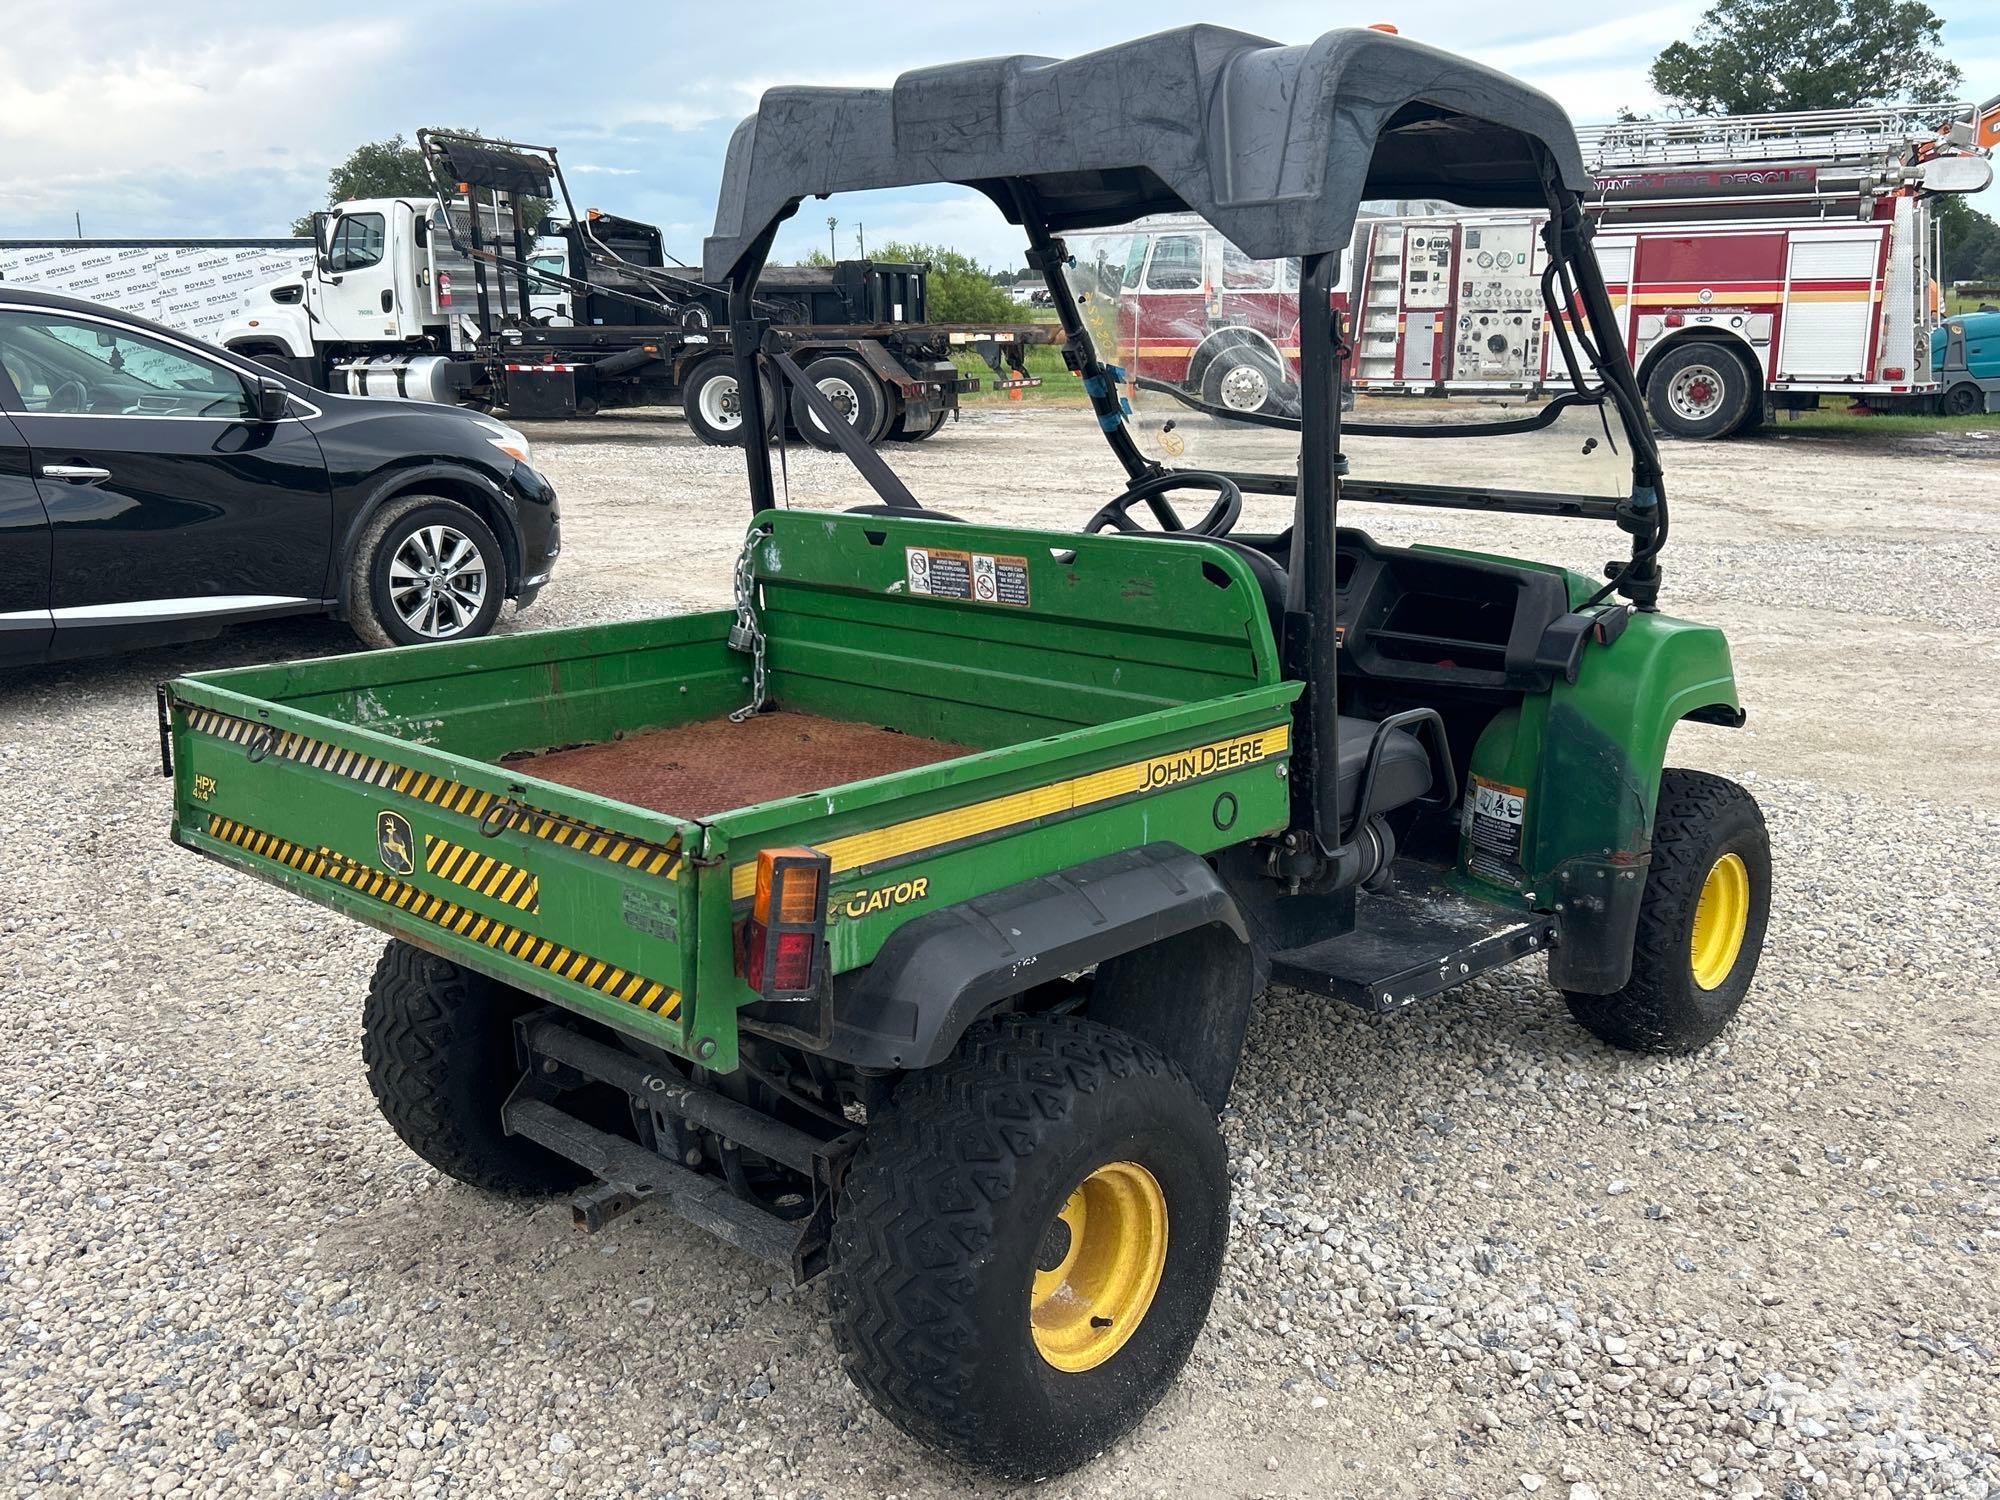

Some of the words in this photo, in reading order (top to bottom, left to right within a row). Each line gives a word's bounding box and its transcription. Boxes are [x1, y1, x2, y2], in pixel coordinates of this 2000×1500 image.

[1140, 756, 1196, 790] JOHN
[1201, 738, 1264, 773] DEERE
[196, 774, 217, 794] HPX
[847, 878, 928, 917] GATOR
